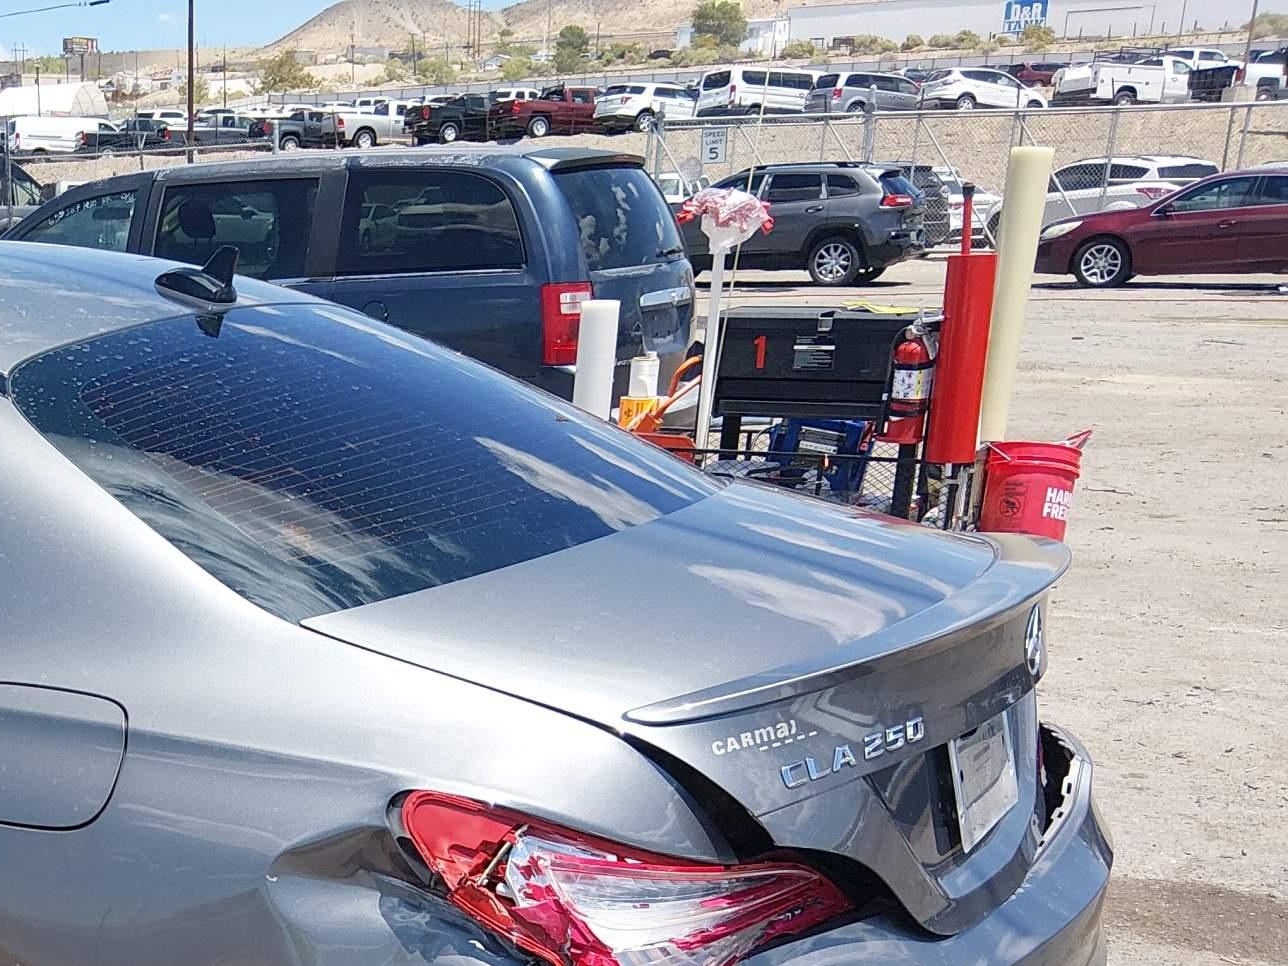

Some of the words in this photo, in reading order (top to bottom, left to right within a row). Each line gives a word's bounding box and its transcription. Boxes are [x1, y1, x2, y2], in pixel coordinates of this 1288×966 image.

[1011, 3, 1045, 20] D&R
[708, 147, 719, 160] 5
[753, 335, 767, 369] 1
[780, 744, 857, 790] CLA
[863, 715, 925, 761] 250
